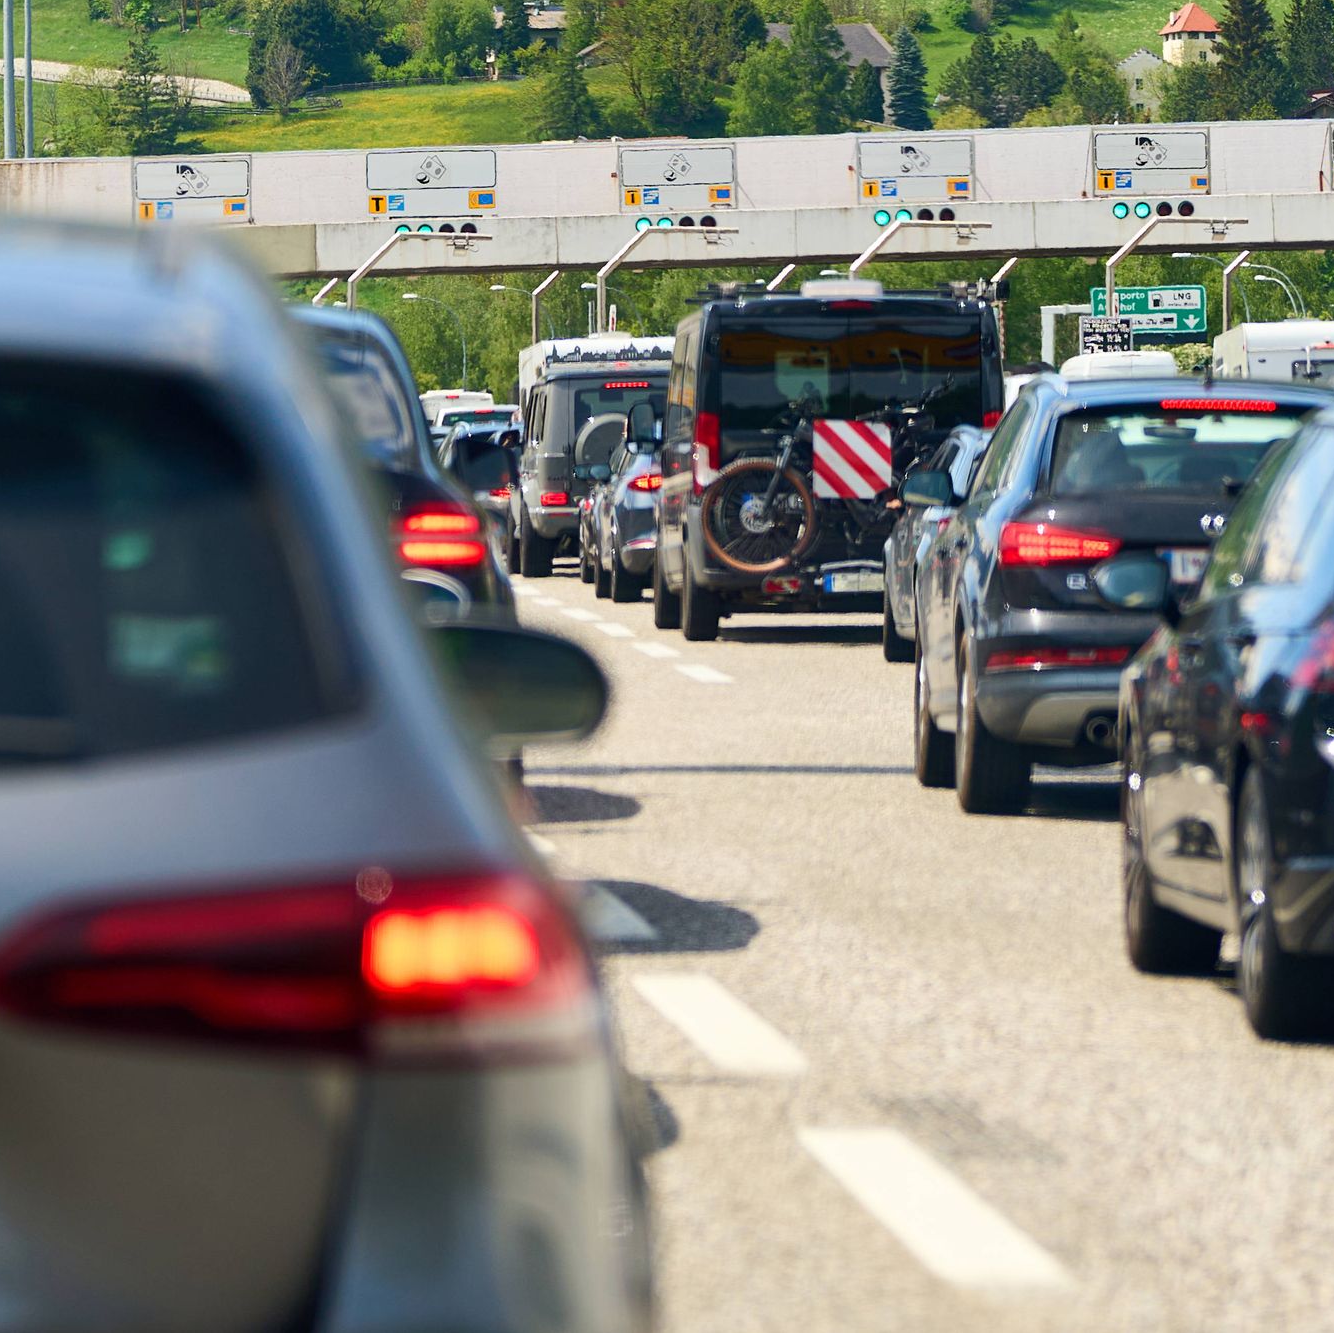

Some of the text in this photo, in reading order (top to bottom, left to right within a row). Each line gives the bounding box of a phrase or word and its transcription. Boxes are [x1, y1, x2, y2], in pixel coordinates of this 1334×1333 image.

[1099, 172, 1113, 189] T
[626, 189, 638, 204] T
[371, 197, 384, 212] T
[1097, 292, 1145, 301] Aporto
[1173, 292, 1191, 300] LNG
[1097, 302, 1136, 311] Ahof
